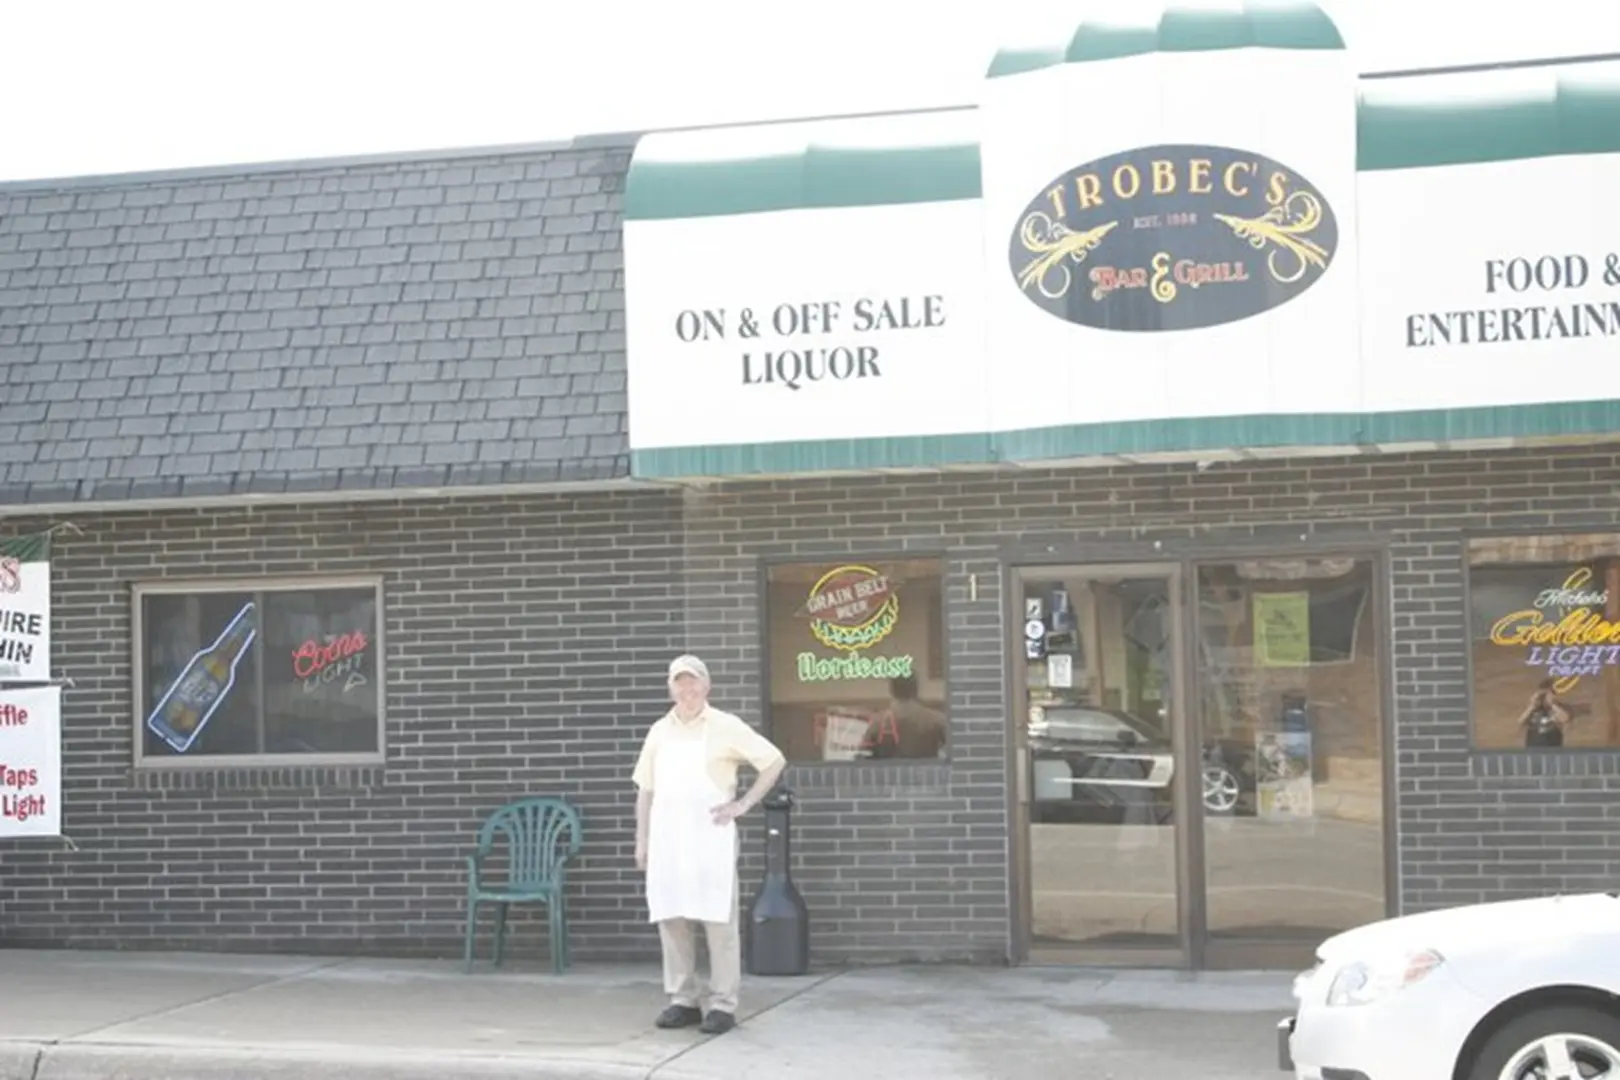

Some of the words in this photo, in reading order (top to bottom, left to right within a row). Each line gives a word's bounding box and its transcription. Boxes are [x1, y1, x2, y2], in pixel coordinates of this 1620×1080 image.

[1048, 159, 1289, 218] TROBEC'S
[1150, 252, 1177, 302] &
[1485, 254, 1589, 293] FOOD
[1602, 252, 1620, 286] &
[675, 308, 726, 343] ON
[738, 307, 761, 339] &
[772, 301, 842, 337] OFF
[852, 295, 947, 332] SALE
[742, 346, 881, 391] LIQUOR
[0, 608, 42, 636] IRE
[291, 630, 367, 678] Coors
[1526, 644, 1620, 666] LIGHT
[812, 710, 899, 746] PZA
[3, 793, 46, 822] Light
